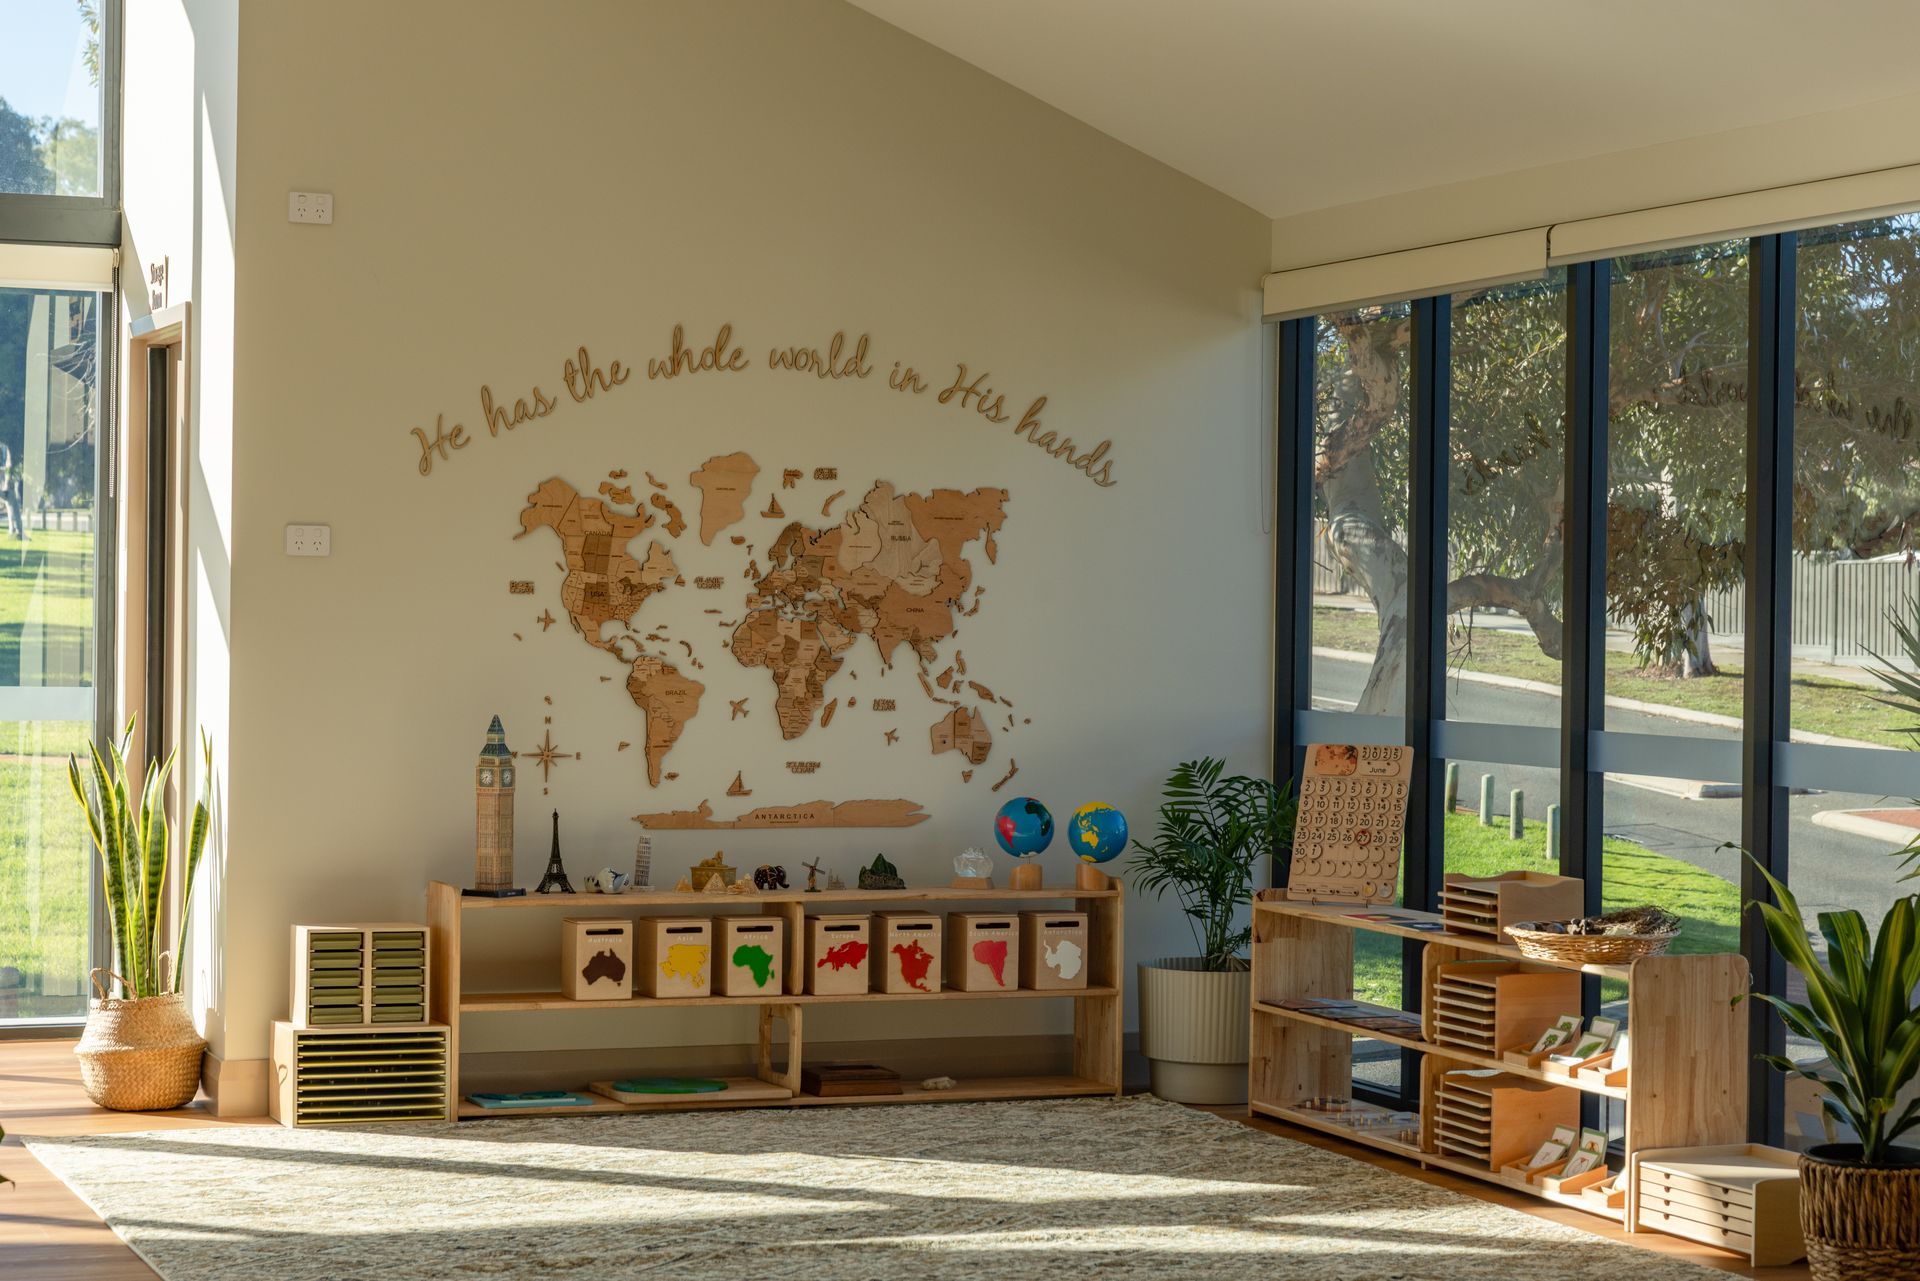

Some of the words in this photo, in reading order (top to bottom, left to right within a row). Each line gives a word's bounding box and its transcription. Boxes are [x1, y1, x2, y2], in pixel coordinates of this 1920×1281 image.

[410, 414, 471, 476] He
[481, 384, 557, 437] has
[563, 346, 630, 403] the
[648, 322, 750, 380] whole
[769, 331, 873, 379] world
[889, 361, 928, 394] in
[938, 363, 1010, 423] His
[1014, 396, 1118, 487] hands
[576, 752, 581, 760] E
